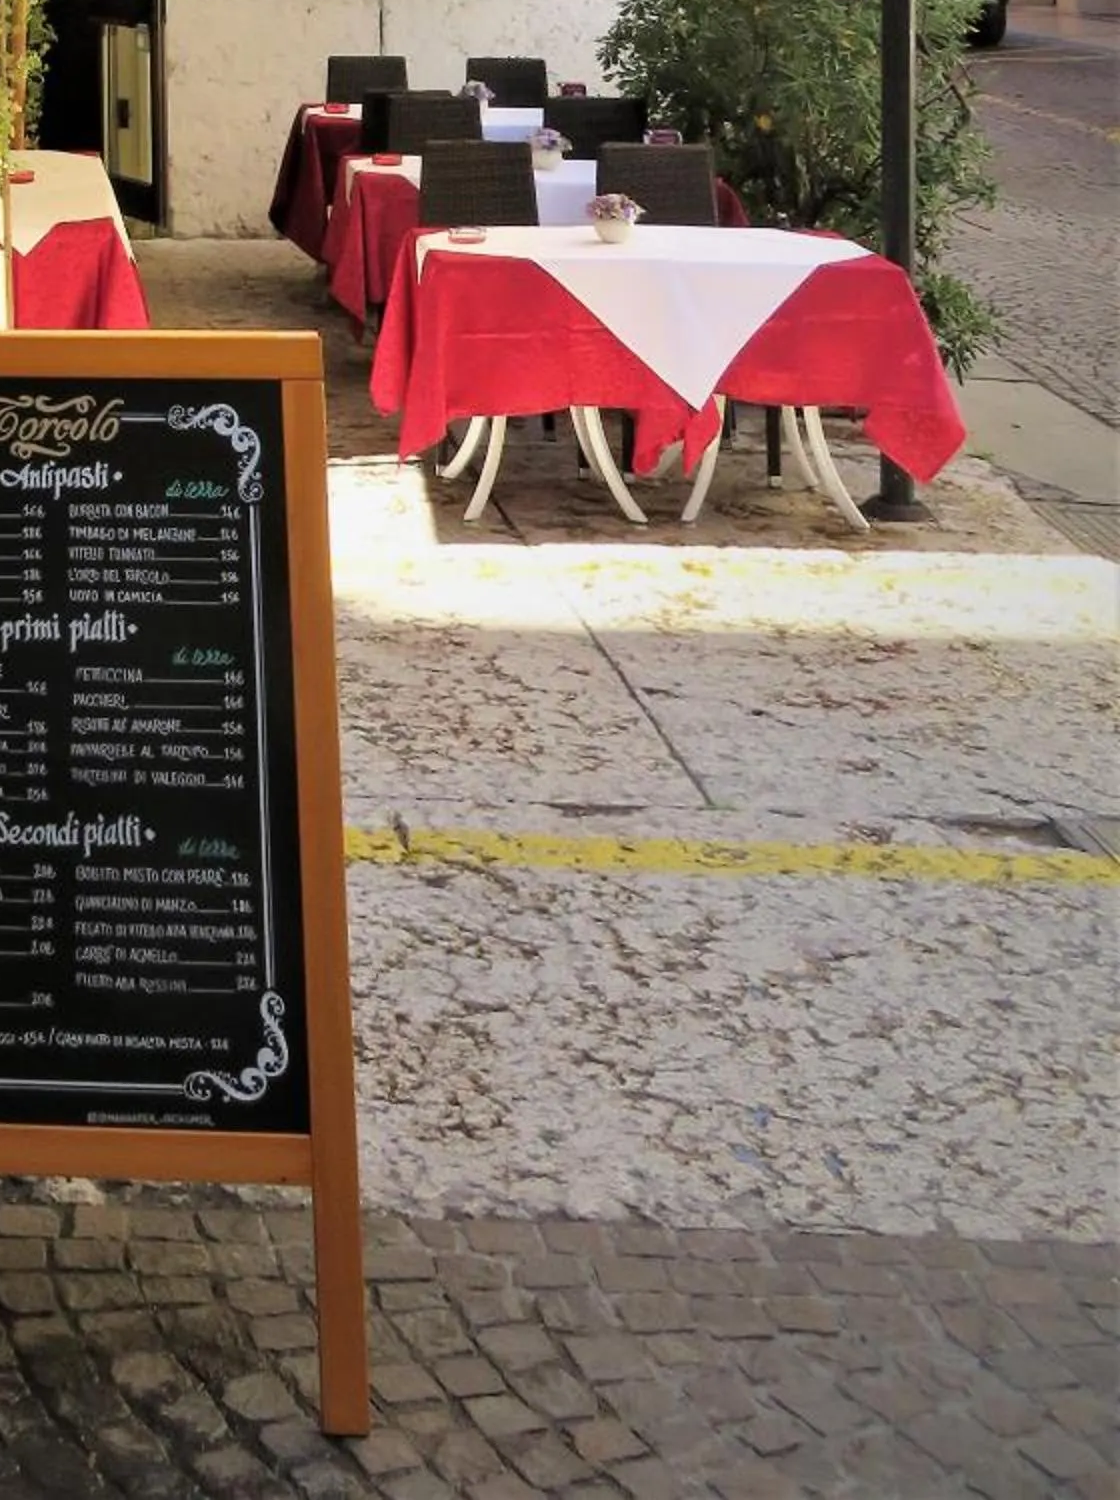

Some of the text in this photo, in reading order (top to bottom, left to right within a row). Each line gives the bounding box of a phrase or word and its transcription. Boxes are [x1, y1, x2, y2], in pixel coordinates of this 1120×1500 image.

[0, 460, 109, 500] Antipasti
[0, 613, 61, 652] primi
[69, 609, 128, 653] piatti
